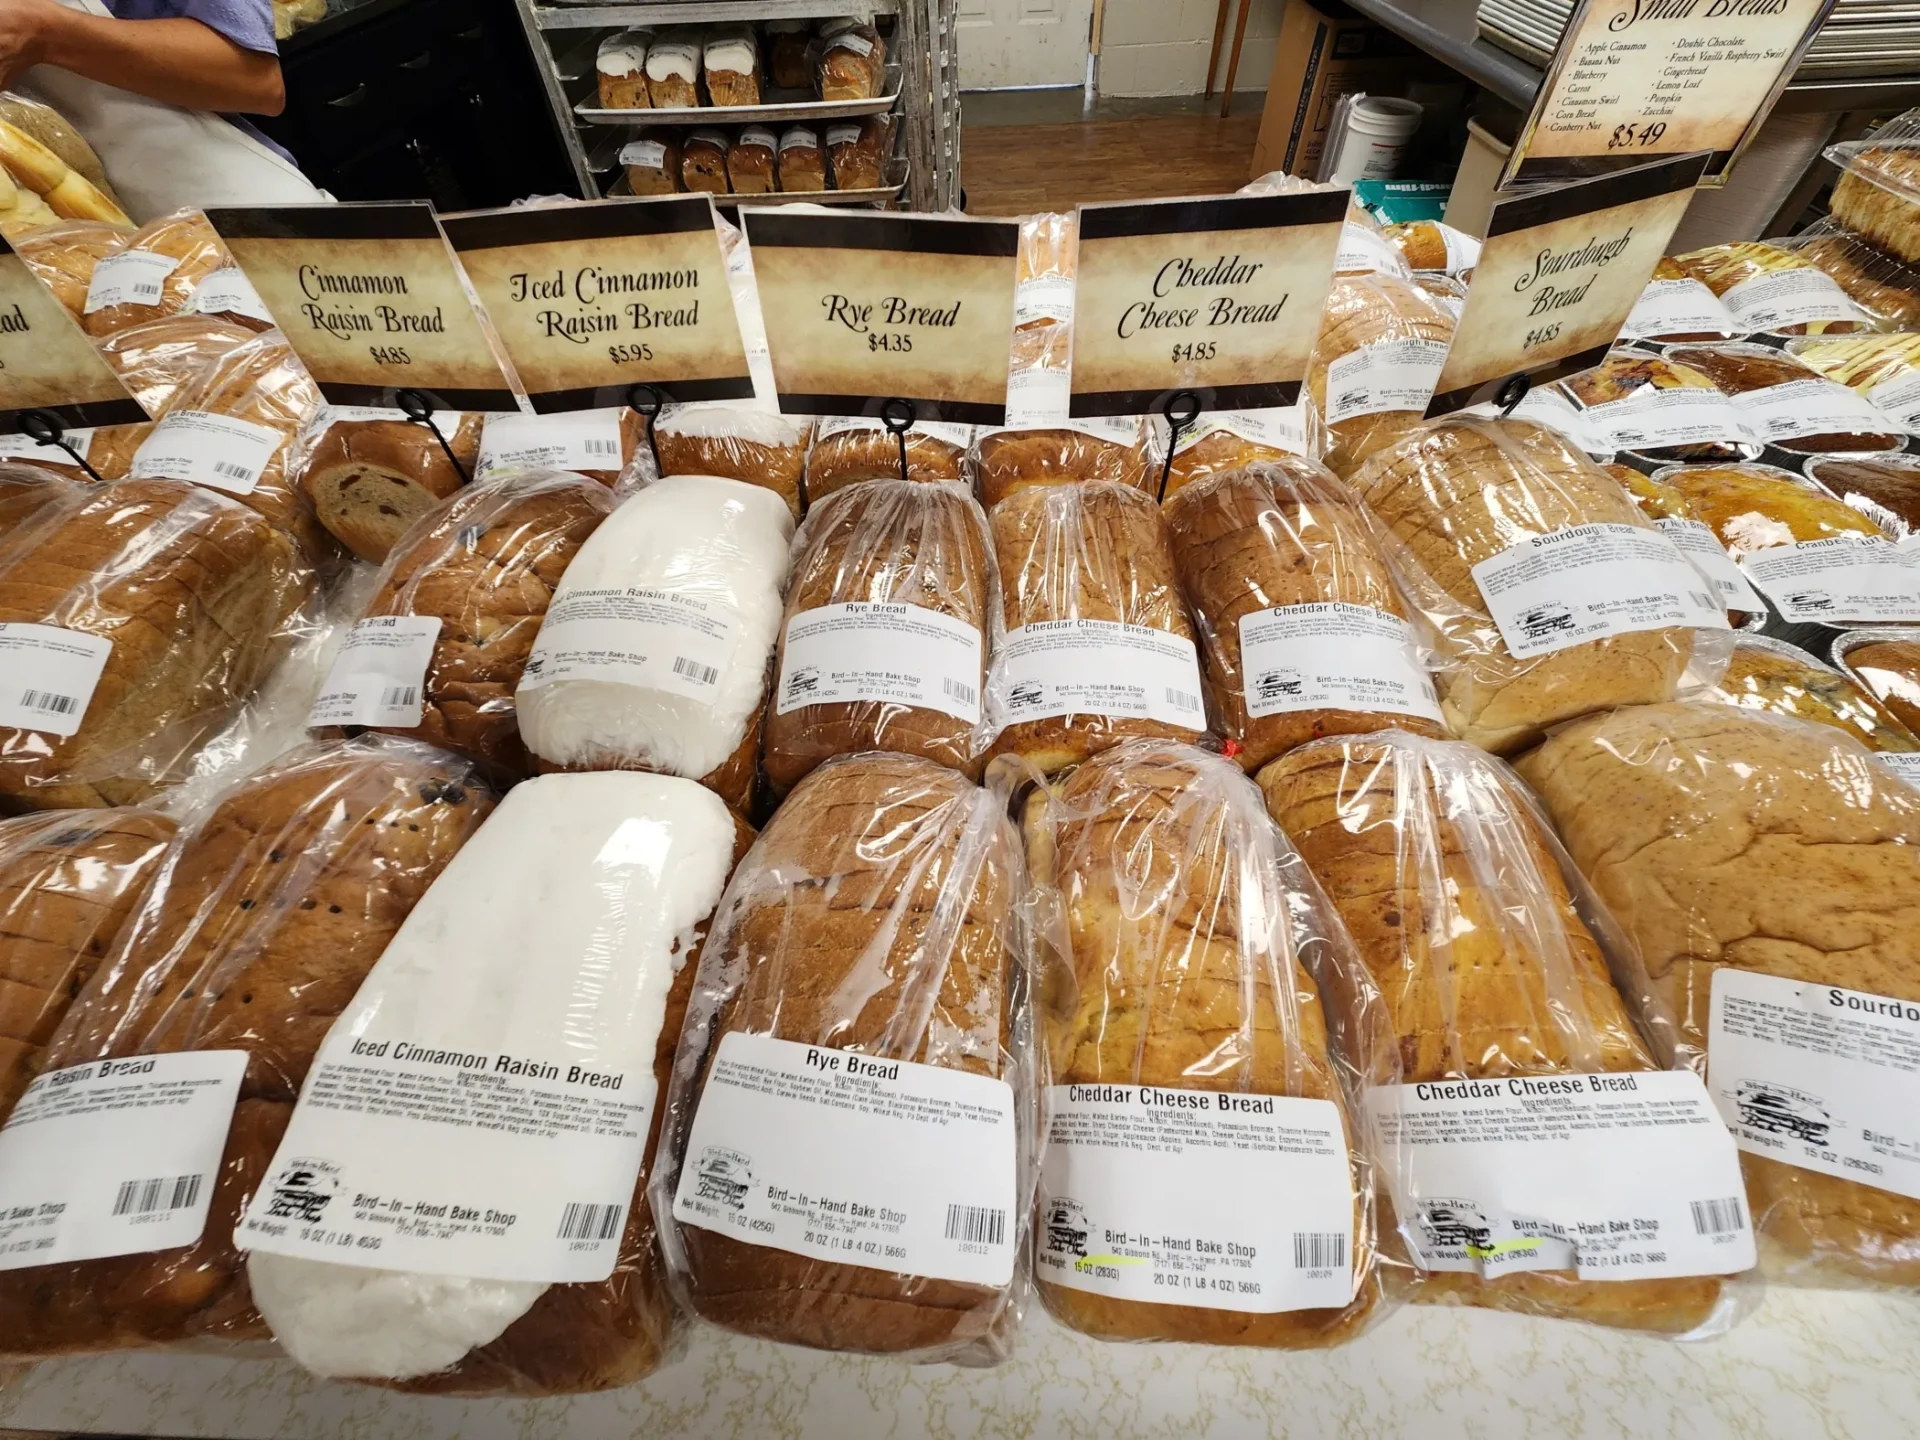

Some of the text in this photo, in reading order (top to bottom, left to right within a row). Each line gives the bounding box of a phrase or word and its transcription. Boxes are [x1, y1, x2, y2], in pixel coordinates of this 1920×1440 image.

[1585, 41, 1647, 53] Apple Cinnamon
[1677, 37, 1746, 49] Double Chocolate
[1579, 56, 1621, 66] Banana Nut
[1670, 48, 1787, 63] French Vanilla Raspberry Swirl
[1573, 70, 1608, 81] Blueberry
[1663, 65, 1708, 77] Gingerbread
[1568, 84, 1591, 93] Carrot
[1656, 79, 1703, 90] Lemon Loaf
[1561, 95, 1620, 106] Cinnamon Swirl
[1649, 93, 1682, 104] Pumpkin
[1556, 109, 1596, 119] Corn Bread
[1642, 106, 1675, 116] Zucchini
[1550, 121, 1602, 133] Cranberry Nut
[1607, 122, 1667, 150] $5.49
[1513, 226, 1634, 293] Sourdough
[299, 264, 409, 301] Cinnamon
[509, 267, 699, 304] Iced Cinnamon
[1152, 255, 1264, 298] Cheddar
[1526, 273, 1598, 317] Bread
[301, 302, 445, 341] Raisin Bread
[536, 300, 699, 344] Raisin Bread
[821, 294, 962, 333] Rye Bread
[1117, 293, 1289, 339] Cheese Bread
[867, 333, 913, 352] $4.35
[1523, 321, 1563, 350] $4.85
[369, 345, 412, 367] $4.85
[608, 343, 653, 364] $5.95
[1171, 341, 1217, 364] $4.85
[626, 587, 666, 601] Raisin
[670, 592, 708, 612] Bread
[845, 603, 907, 615] Rye Bread
[1273, 603, 1402, 626] Cheddar Cheese Bread
[1024, 619, 1155, 637] Cheddar Cheese Bread
[98, 1058, 157, 1079] Bread
[350, 1037, 624, 1091] Iced Cinnamon Raisin Bread
[806, 1049, 899, 1081] Rye Bread
[1416, 1074, 1638, 1102] Cheddar Cheese Bread
[1069, 1085, 1275, 1115] Cheddar Cheese Bread
[1804, 1146, 1819, 1158] 15
[1821, 1151, 1838, 1163] OZ
[681, 1197, 694, 1209] Net
[450, 1206, 480, 1222] Bake
[484, 1209, 517, 1227] Shop
[850, 1203, 876, 1219] Bake
[879, 1208, 907, 1225] Shop
[737, 1215, 748, 1228] OZ
[748, 1218, 775, 1235] (425G)
[1609, 1219, 1631, 1233] Bake
[1633, 1217, 1660, 1231] Shop
[804, 1231, 907, 1259] 20 OZ (1 LB 4 OZ.) 566G
[957, 1243, 989, 1255] 100112
[1196, 1239, 1222, 1254] Bake
[1227, 1242, 1256, 1259] Shop
[1074, 1261, 1120, 1281] 15 OZ (283G)
[1153, 1273, 1261, 1294] 20 OZ (1 LB 4 OZ) 566G
